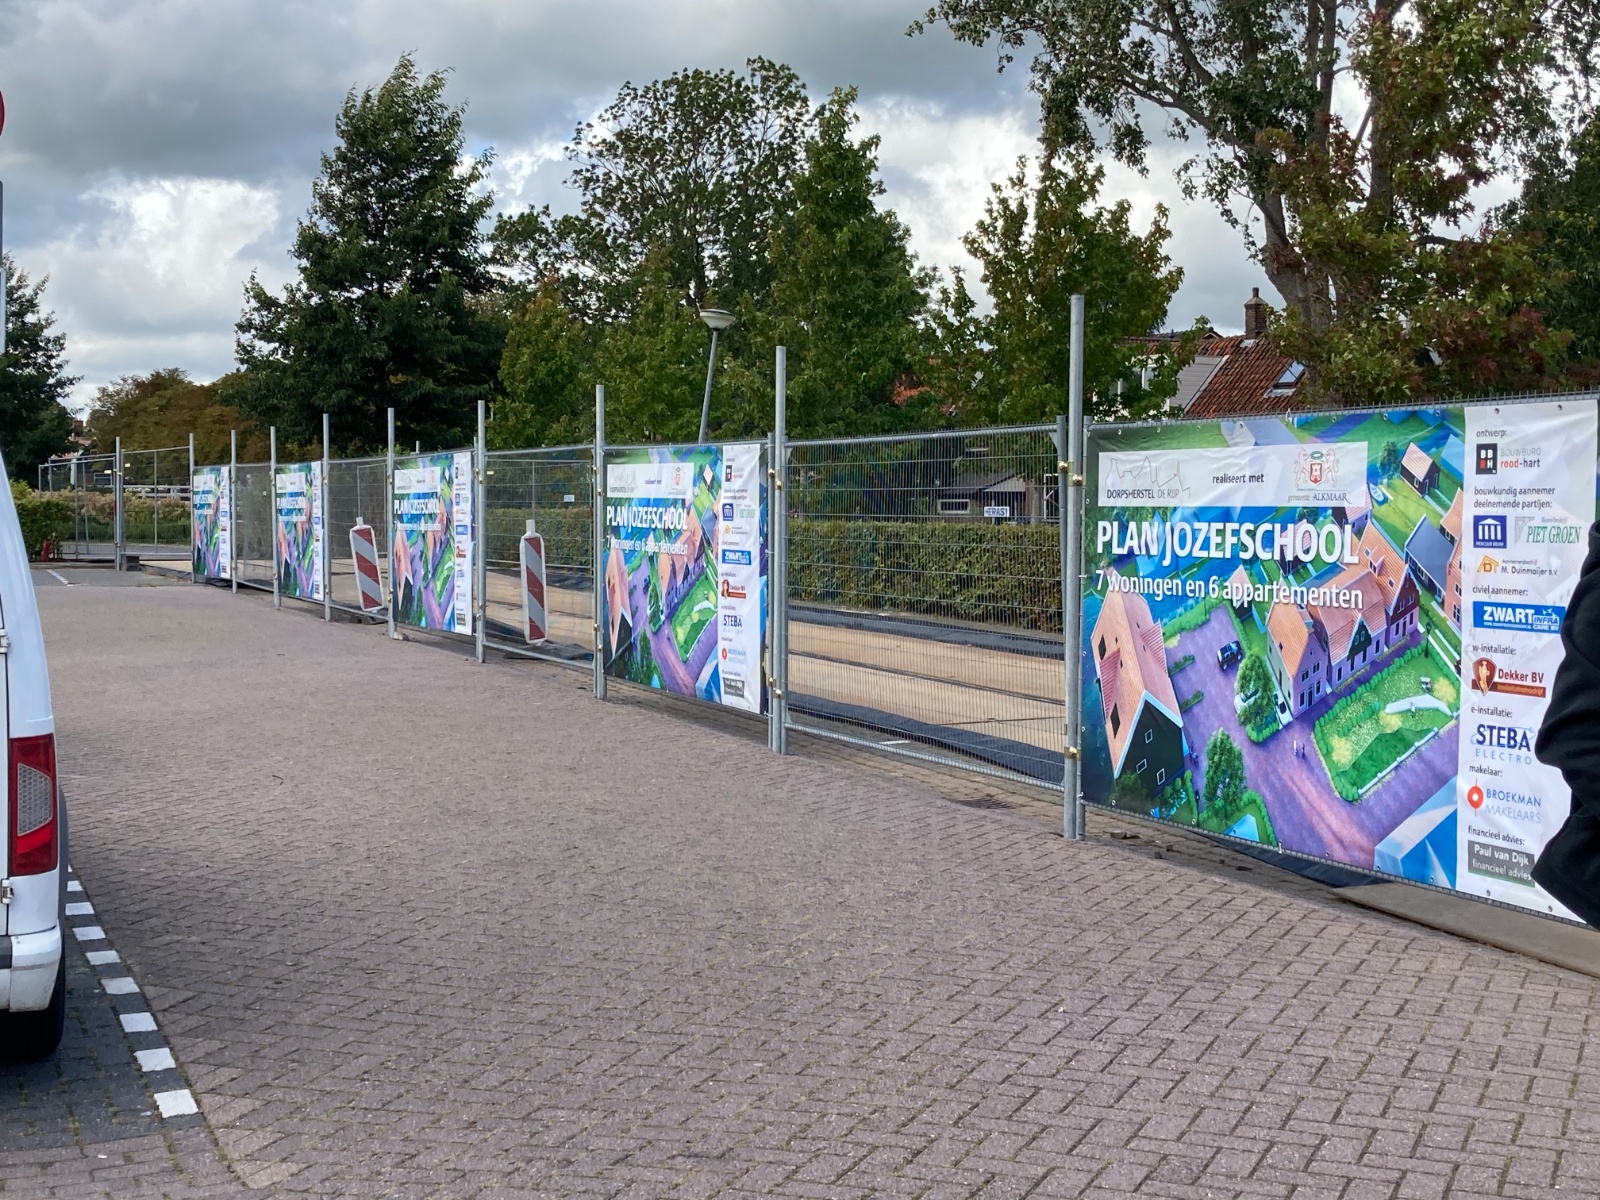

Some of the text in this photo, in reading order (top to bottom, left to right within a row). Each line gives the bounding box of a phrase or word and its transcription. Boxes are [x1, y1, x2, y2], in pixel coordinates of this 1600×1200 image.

[1476, 429, 1507, 438] ontwerp:
[1500, 448, 1541, 457] BOUWBURO
[1500, 458, 1541, 468] rood-hart
[1212, 473, 1265, 484] realiseert met
[1106, 489, 1155, 499] DORPSHERSTEL
[1157, 489, 1166, 498] DE
[1287, 492, 1351, 504] gemeente ALKMAAR
[1474, 486, 1556, 497] bouwkundig aannemer
[1473, 498, 1552, 510] deelnemende partijen:
[606, 505, 688, 533] PLAN JOZEFSCHOOL
[1526, 526, 1581, 544] PIET GROEN
[1097, 520, 1359, 567] PLAN JOZEFSCHOOL
[1501, 566, 1509, 574] M.
[1511, 566, 1547, 576] Duinmaijer
[1096, 569, 1363, 609] 7 woningen en 6 appartementen
[1472, 585, 1529, 596] civiel aannemer:
[723, 614, 742, 628] STEBA
[1483, 606, 1535, 624] ZWART
[1534, 616, 1559, 625] INFRA
[1472, 644, 1517, 656] w-installatie:
[1498, 668, 1545, 684] Dekker BV
[1470, 705, 1513, 719] e-installatie:
[1476, 723, 1531, 752] STEBA
[1475, 748, 1532, 765] ELECTRO
[1469, 765, 1503, 777] makelaar:
[1486, 788, 1541, 807] BROEKMAN
[1485, 804, 1541, 824] MAKELAARS
[1467, 825, 1525, 846] financieel advies:
[1474, 843, 1529, 867] Paul van Dijk
[1472, 858, 1532, 881] financieel advies
